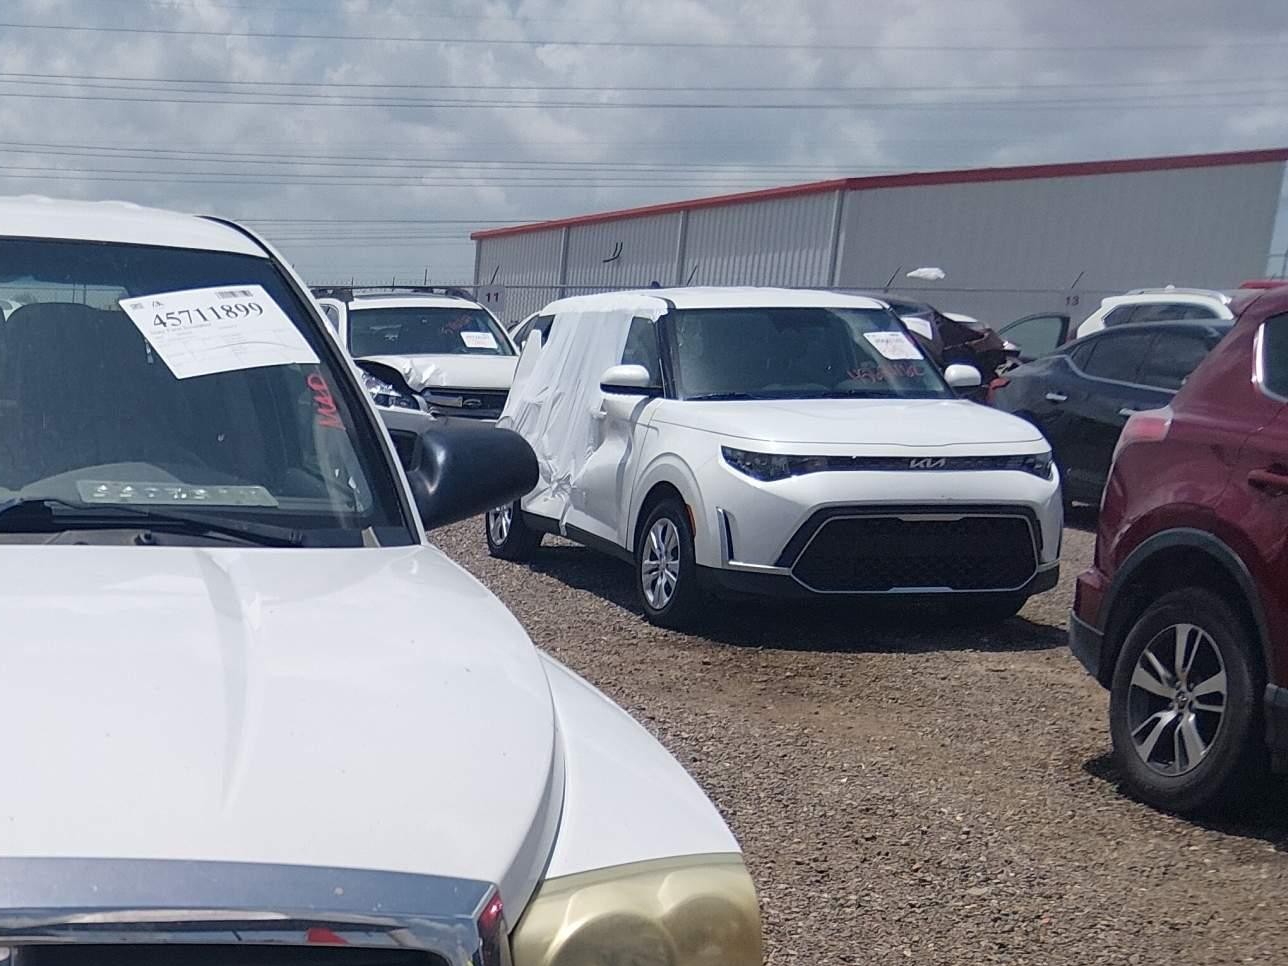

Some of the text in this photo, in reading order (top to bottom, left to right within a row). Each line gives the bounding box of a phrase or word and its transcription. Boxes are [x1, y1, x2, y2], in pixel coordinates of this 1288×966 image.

[485, 292, 499, 303] 11
[1065, 295, 1080, 306] 13
[152, 302, 264, 328] 45711899
[909, 457, 946, 469] KIA
